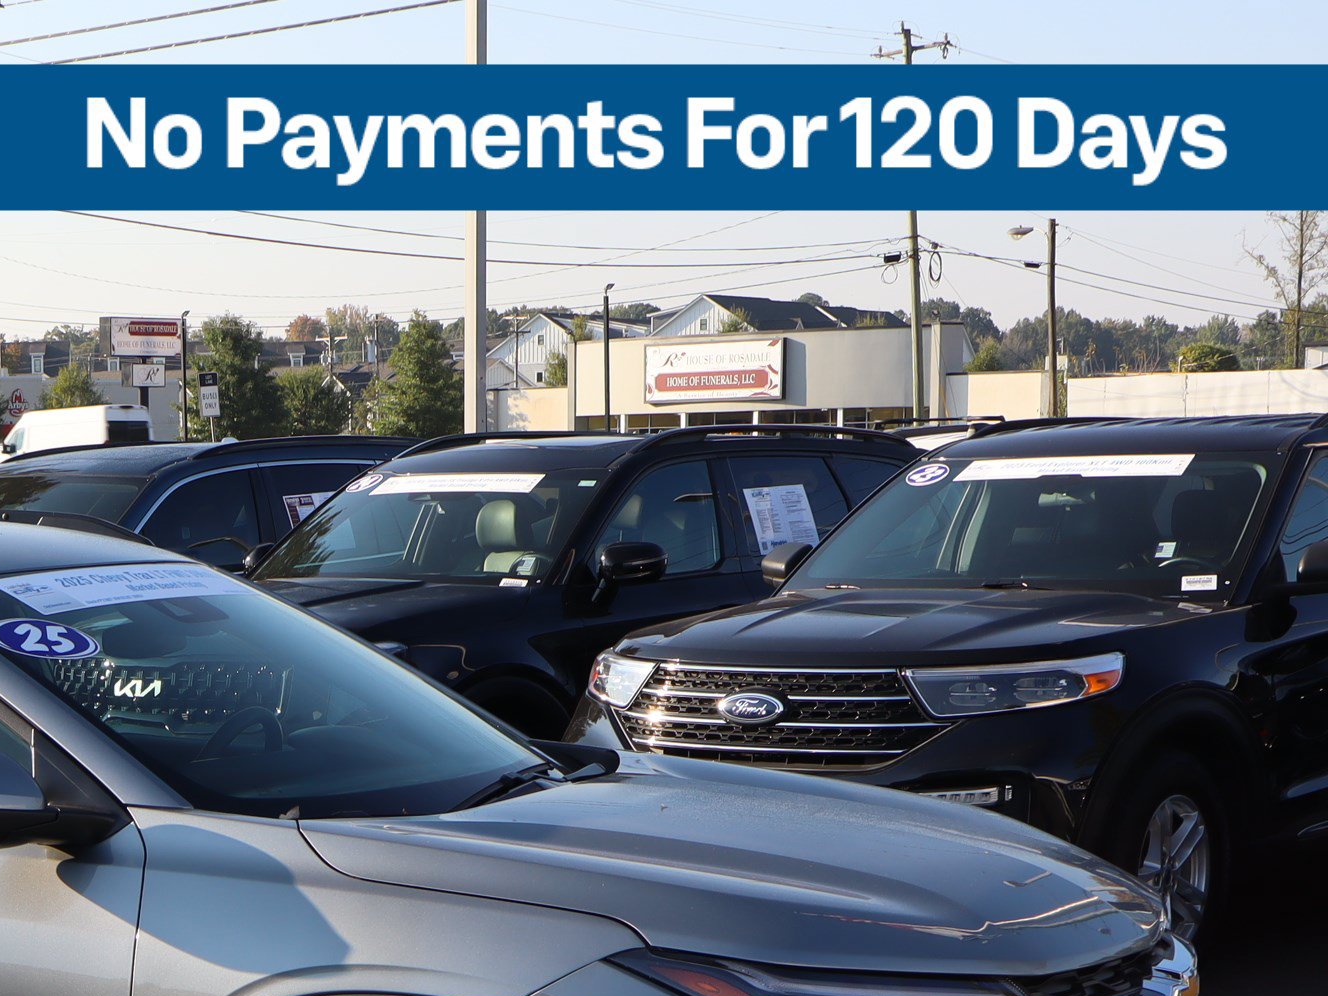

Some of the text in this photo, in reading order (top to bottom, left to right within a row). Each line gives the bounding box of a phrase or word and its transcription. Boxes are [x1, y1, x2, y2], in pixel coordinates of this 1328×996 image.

[686, 353, 713, 366] HOUSE
[715, 353, 727, 365] OF
[729, 351, 771, 364] ROSADALE
[666, 373, 756, 387] HOME OF FUNERALS, LLC
[204, 402, 217, 410] ONLY
[54, 574, 91, 589] 2025
[88, 572, 129, 585] Chevy
[123, 569, 154, 583] Trax
[13, 622, 75, 654] 25
[732, 698, 768, 716] Ford
